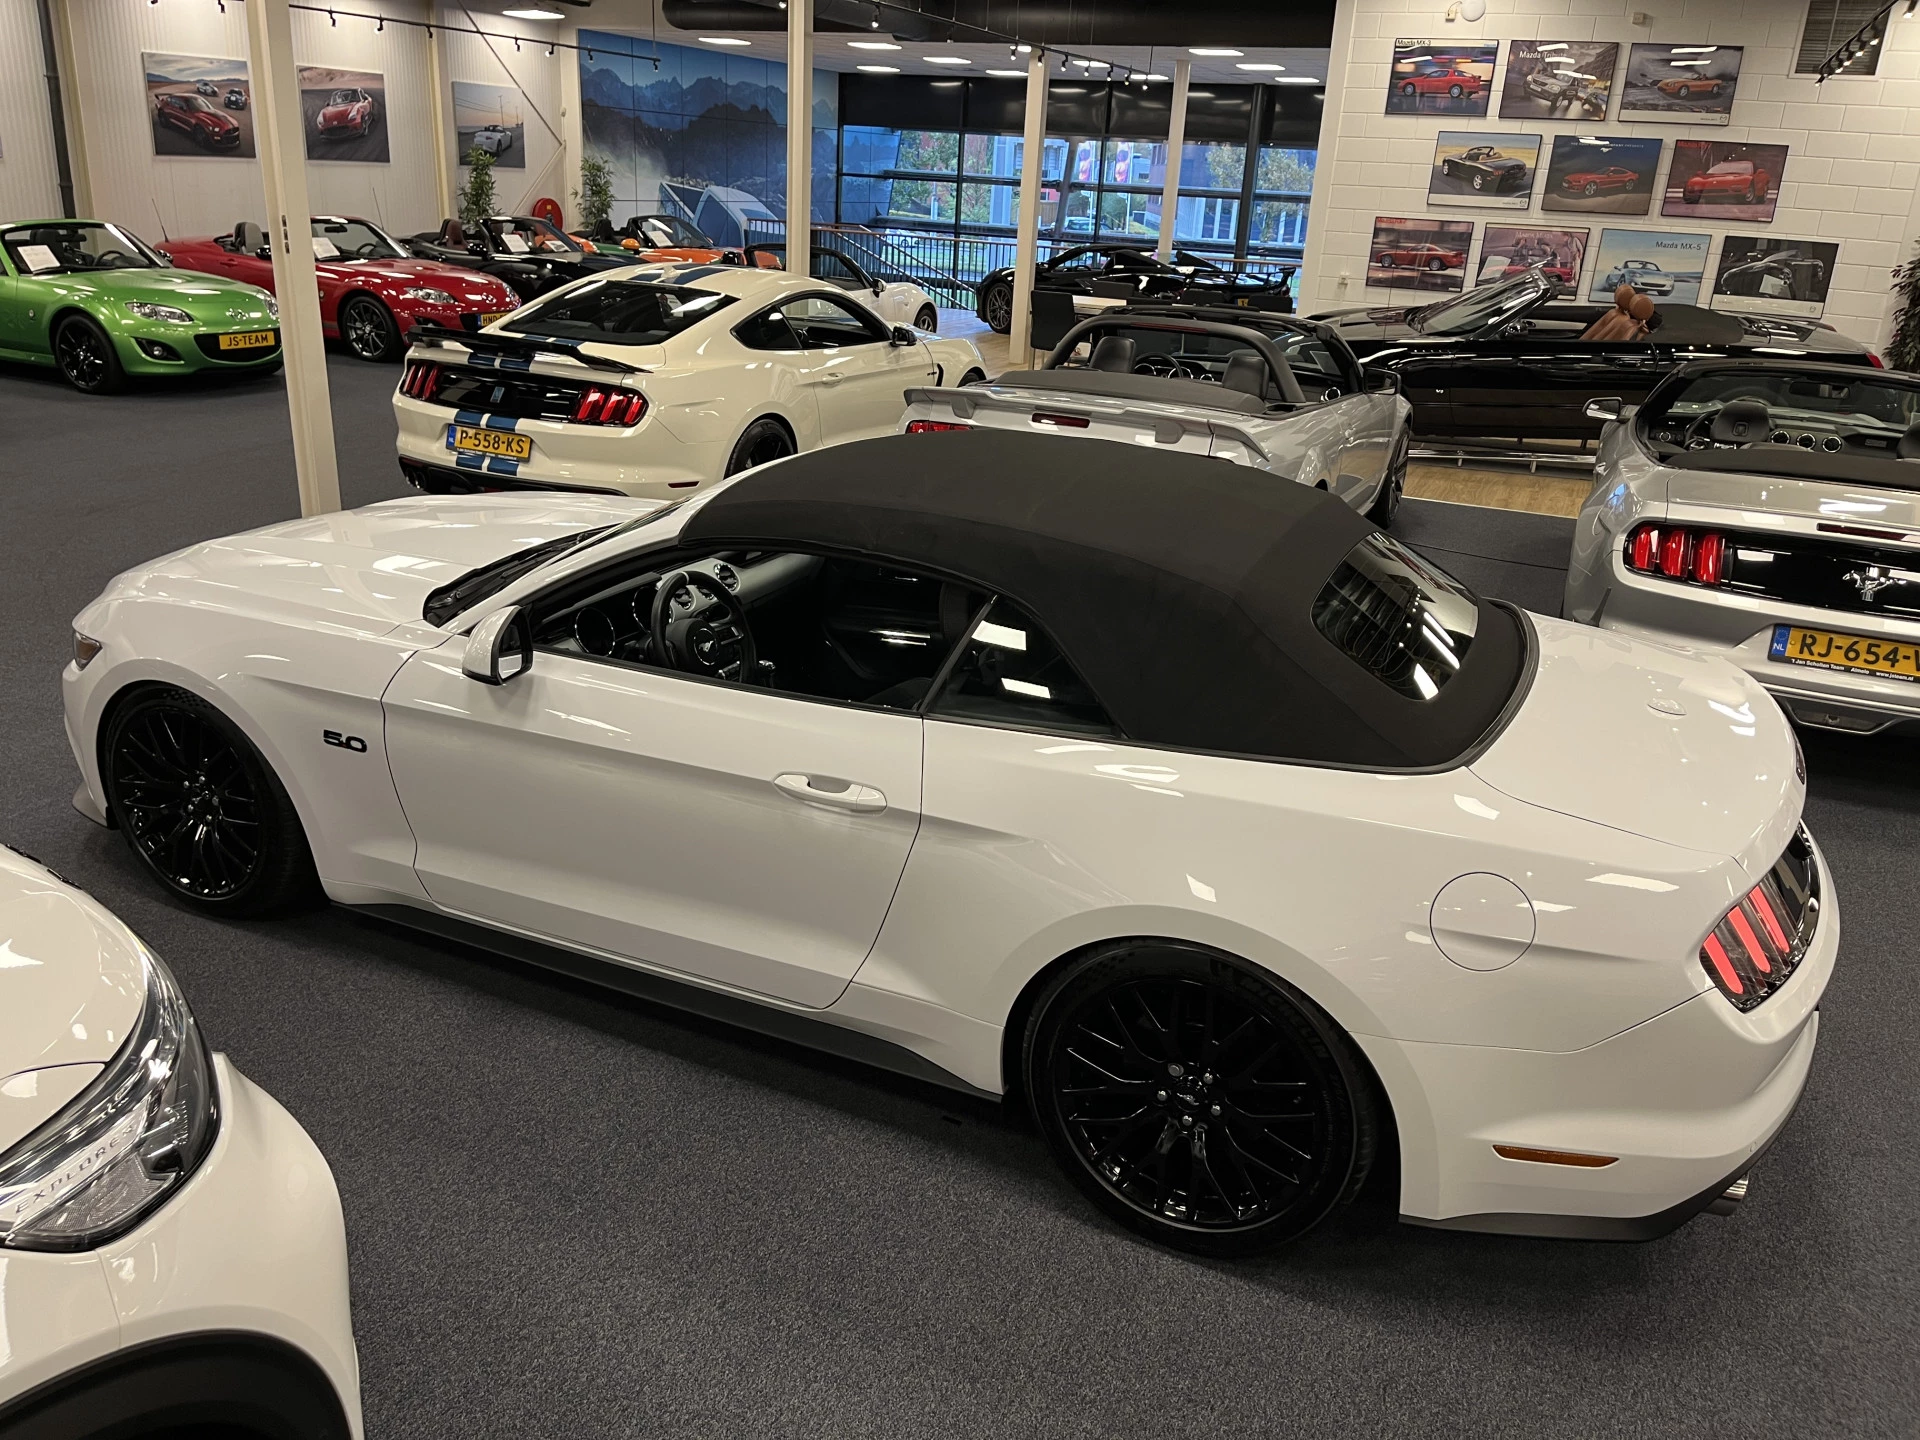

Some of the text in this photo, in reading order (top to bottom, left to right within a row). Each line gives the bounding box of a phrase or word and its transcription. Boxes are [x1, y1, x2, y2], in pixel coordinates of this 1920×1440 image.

[1655, 241, 1702, 250] Mazda MX-5
[227, 333, 269, 347] JS-TEAM
[459, 429, 525, 454] P-558-KS
[1772, 641, 1785, 651] NL
[1806, 661, 1829, 669] Scholten
[323, 729, 368, 753] 5.0
